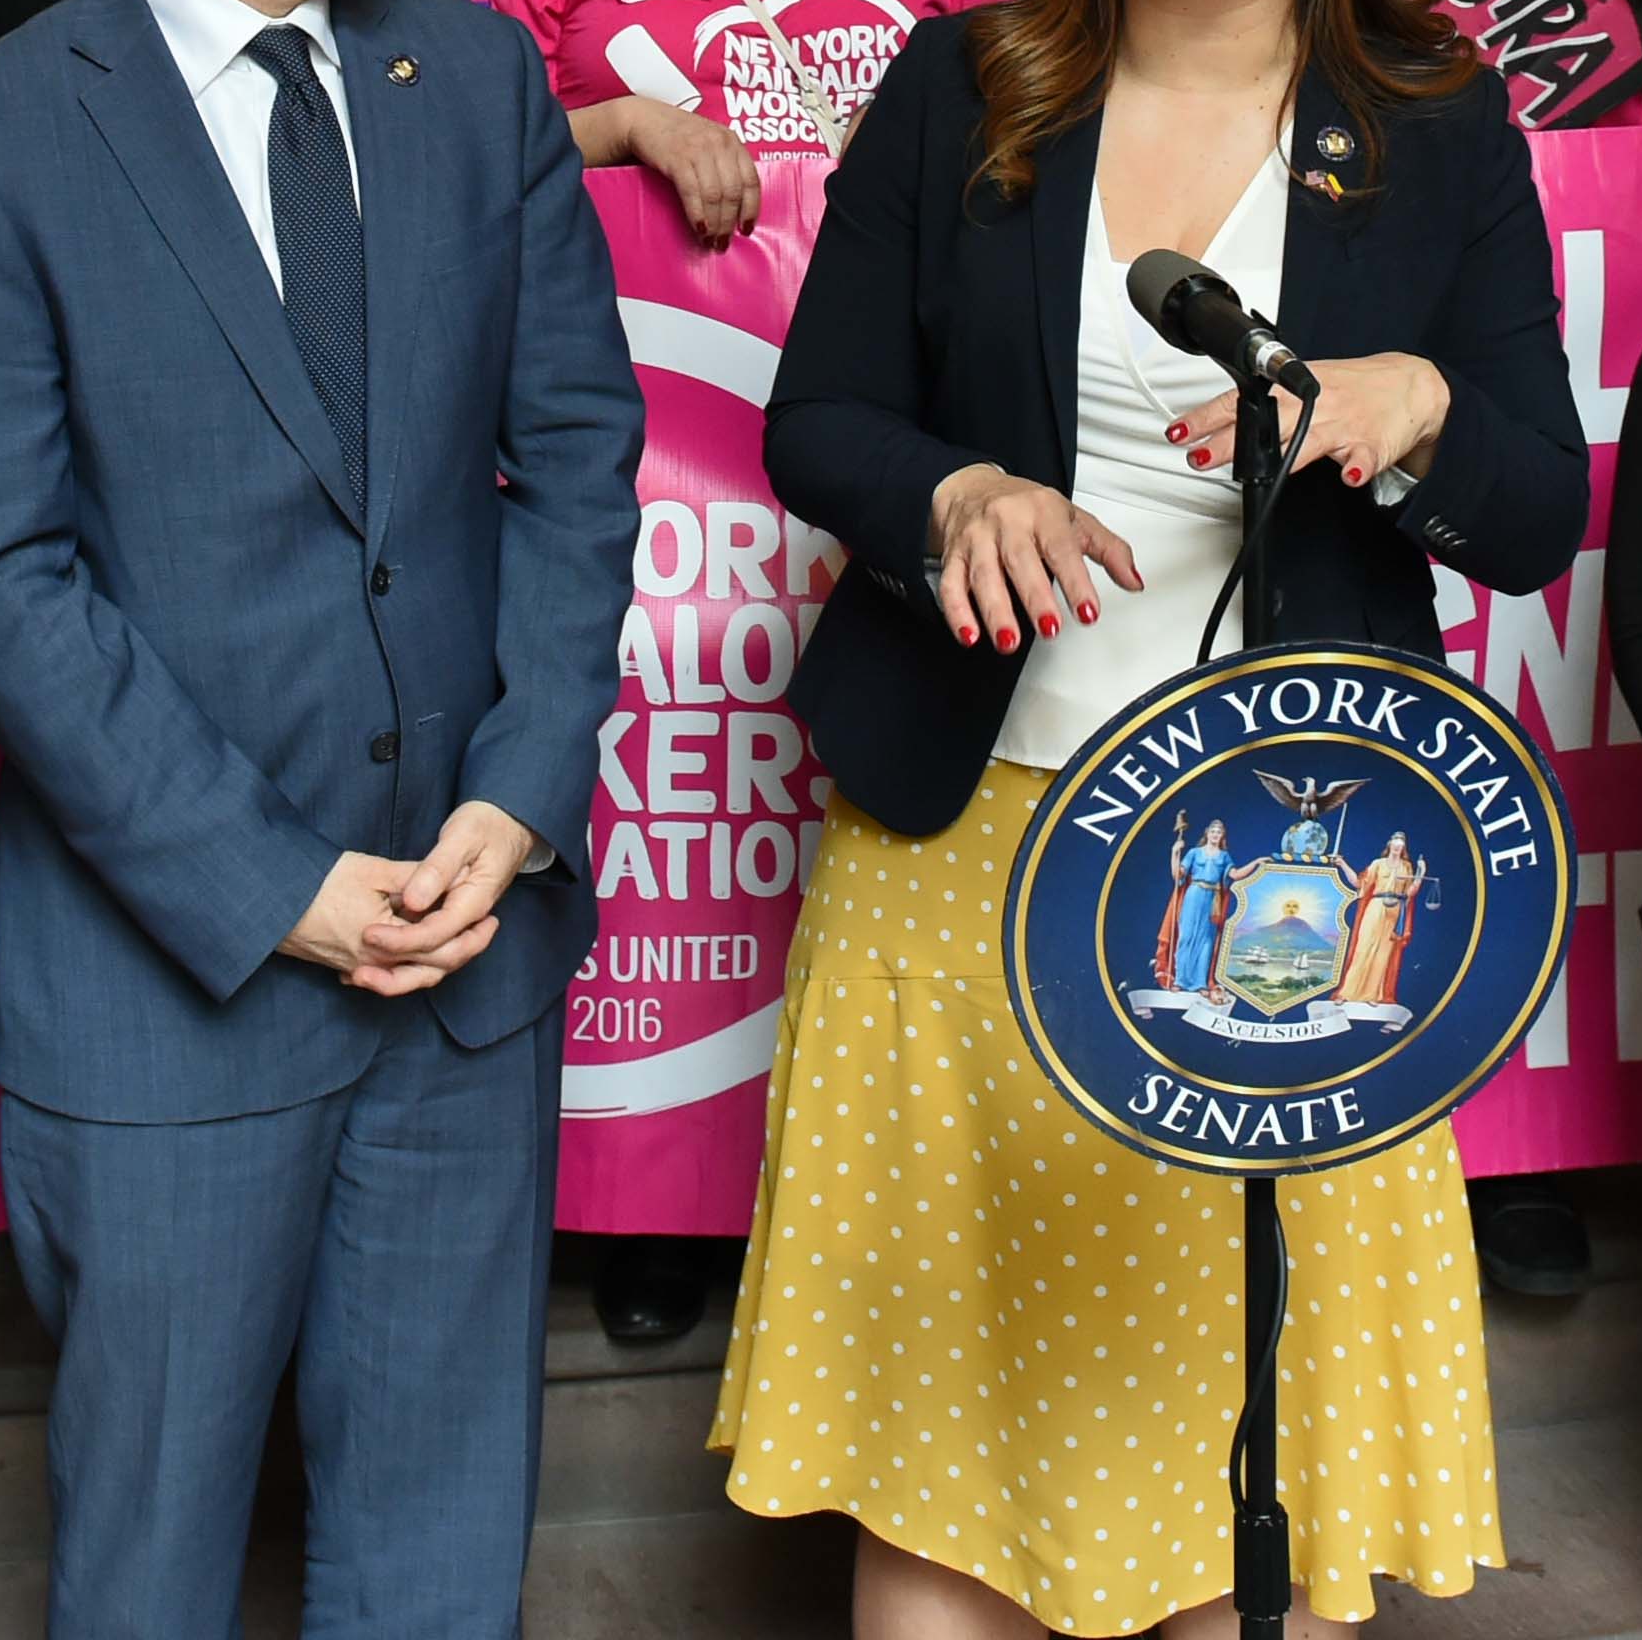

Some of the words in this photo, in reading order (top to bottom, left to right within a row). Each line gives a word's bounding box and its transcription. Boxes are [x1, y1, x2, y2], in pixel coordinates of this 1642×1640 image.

[724, 29, 798, 68] NEW
[804, 24, 901, 65] YORK
[724, 60, 791, 93] NAIL
[728, 117, 824, 145] ASSOC
[617, 603, 824, 705] ALO
[1073, 706, 1205, 846] NEW
[1220, 676, 1423, 742] YORK
[1417, 716, 1538, 877] STATE
[586, 820, 824, 901] ATIO
[609, 934, 758, 983] UNITED
[572, 997, 663, 1045] 2016
[1209, 1016, 1325, 1040] EXCELSIOR
[1127, 1074, 1366, 1147] SENATE
